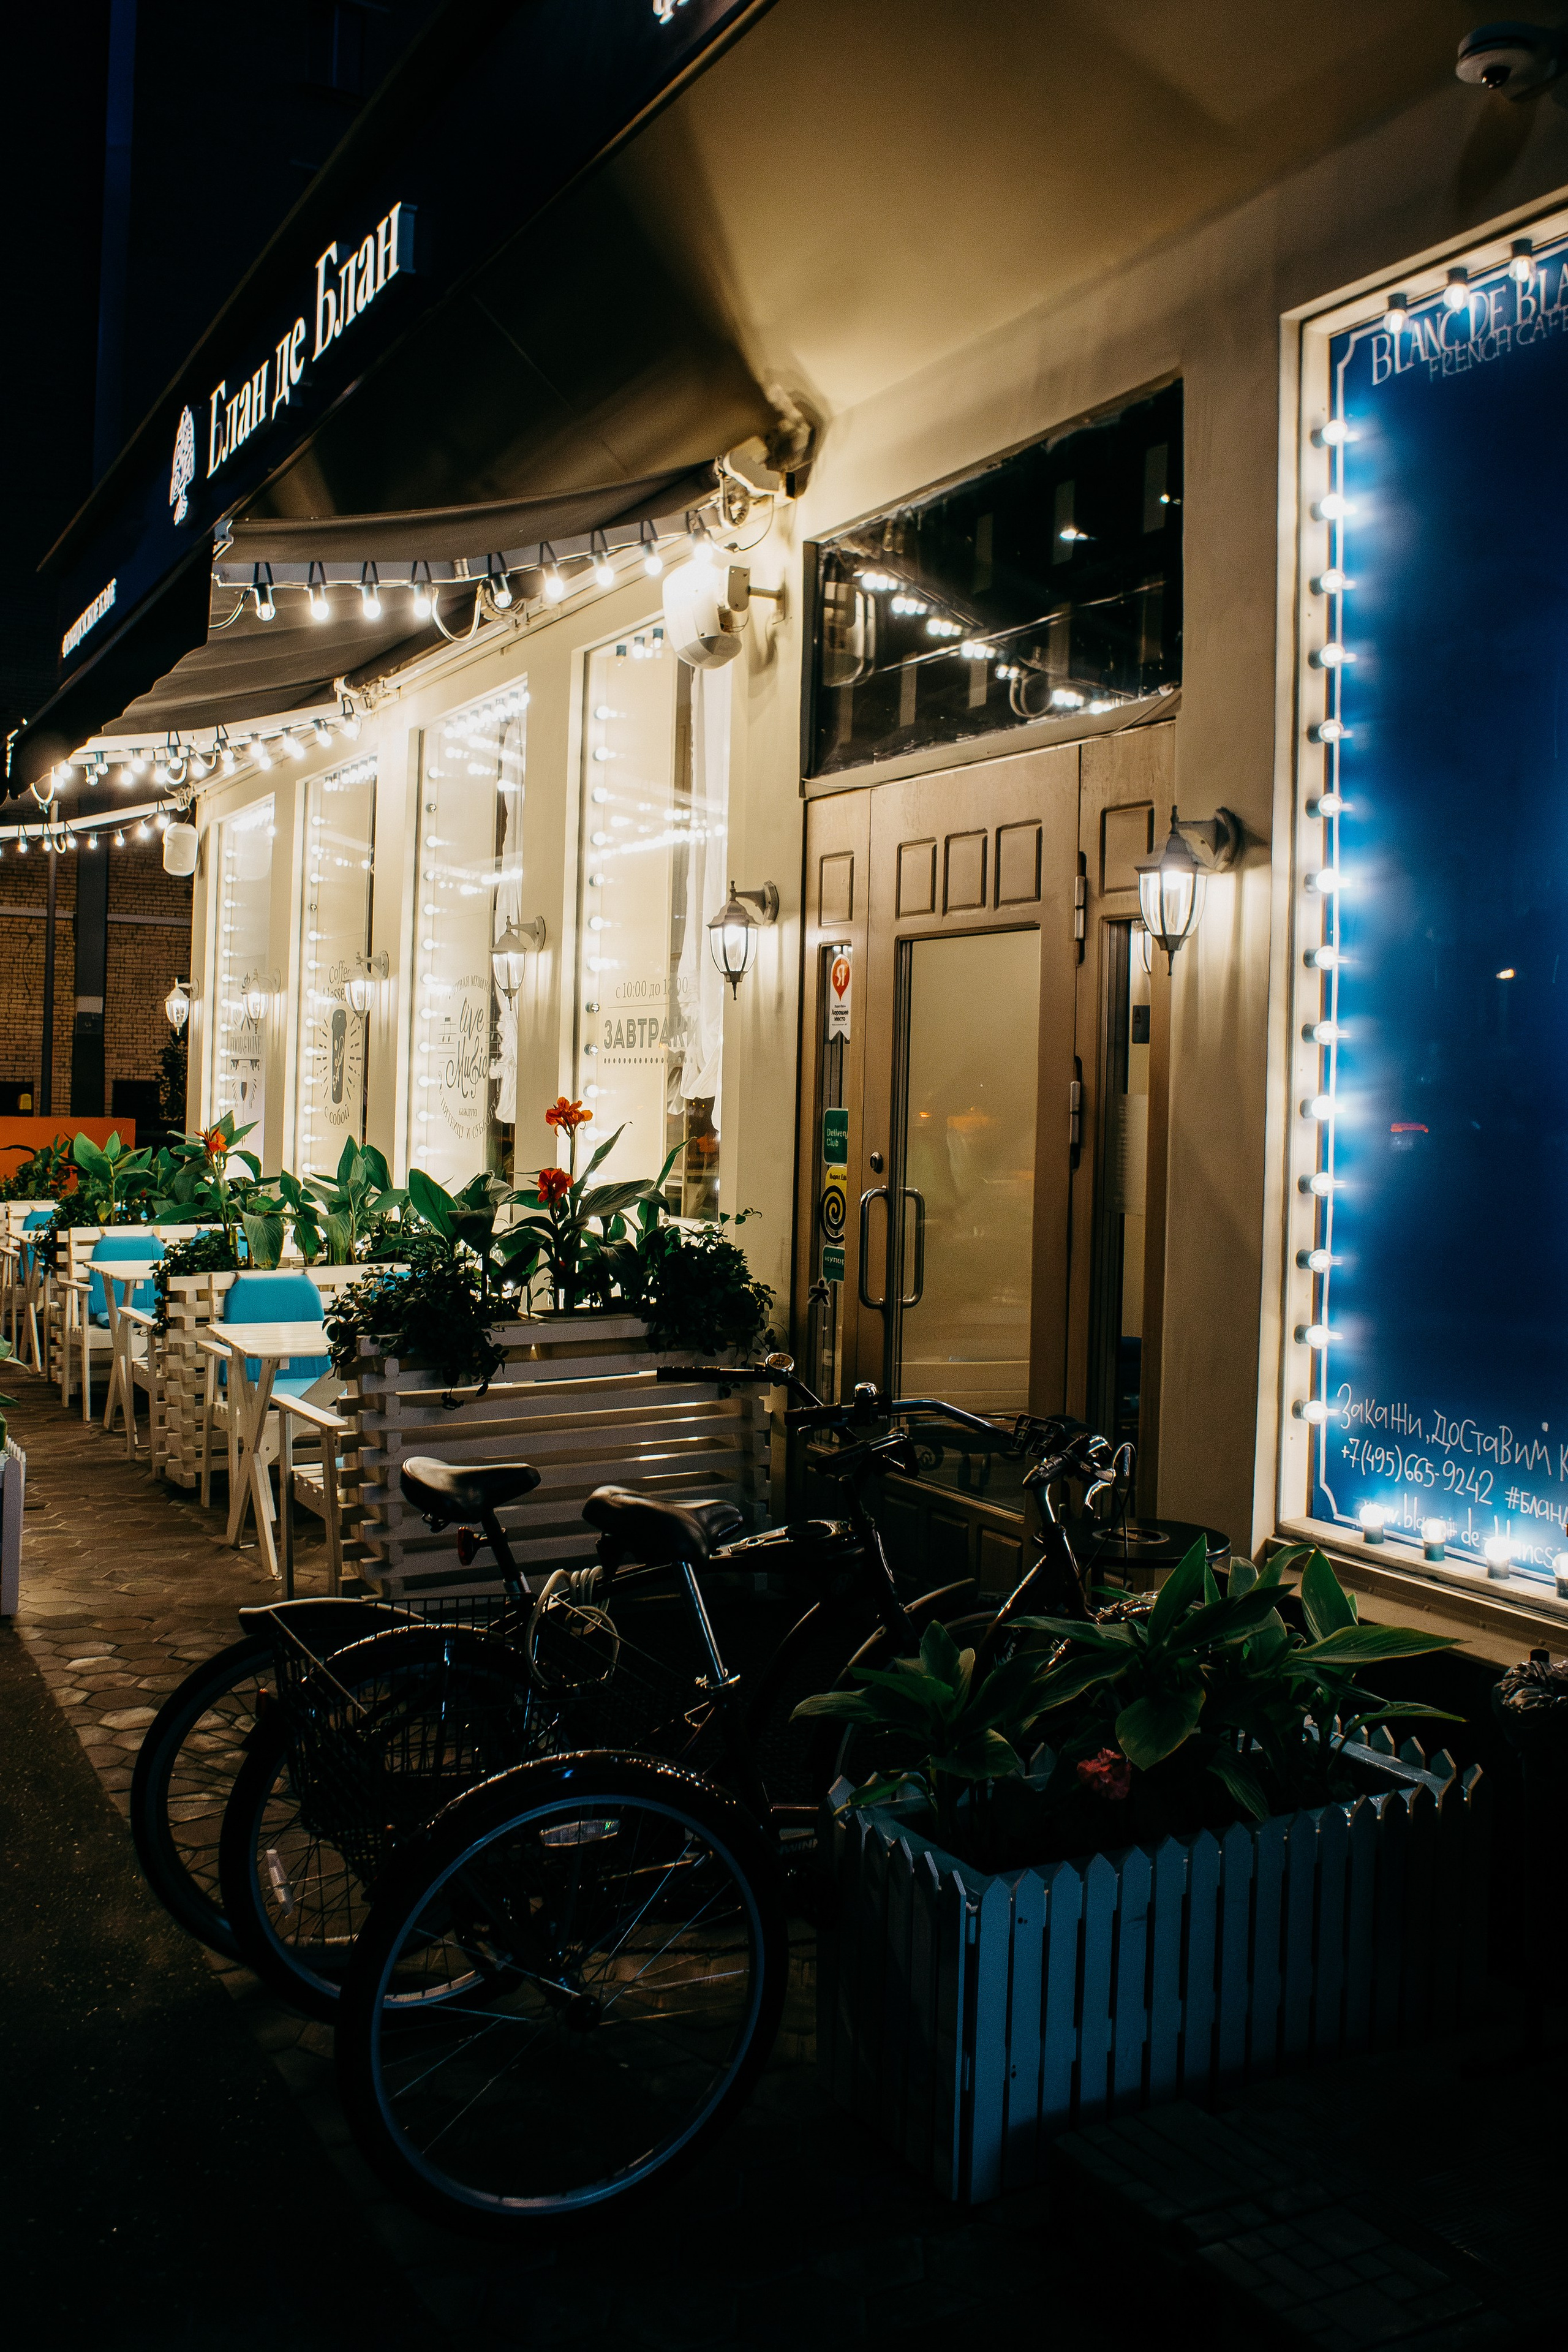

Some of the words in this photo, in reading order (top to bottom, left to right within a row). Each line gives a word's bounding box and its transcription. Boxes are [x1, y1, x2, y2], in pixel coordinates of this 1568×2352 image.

[206, 359, 270, 479] Блан
[272, 317, 306, 421] де
[312, 200, 401, 362] Блан
[1371, 309, 1467, 386] BLANC
[1469, 285, 1507, 343] DE
[1428, 325, 1512, 382] FRENCH
[622, 980, 647, 998] 10:00
[649, 982, 660, 998] до
[459, 997, 484, 1041] live
[826, 1128, 848, 1140] Delivery
[826, 1137, 839, 1147] Club
[1341, 1439, 1493, 1506] +7(495)665-9242
